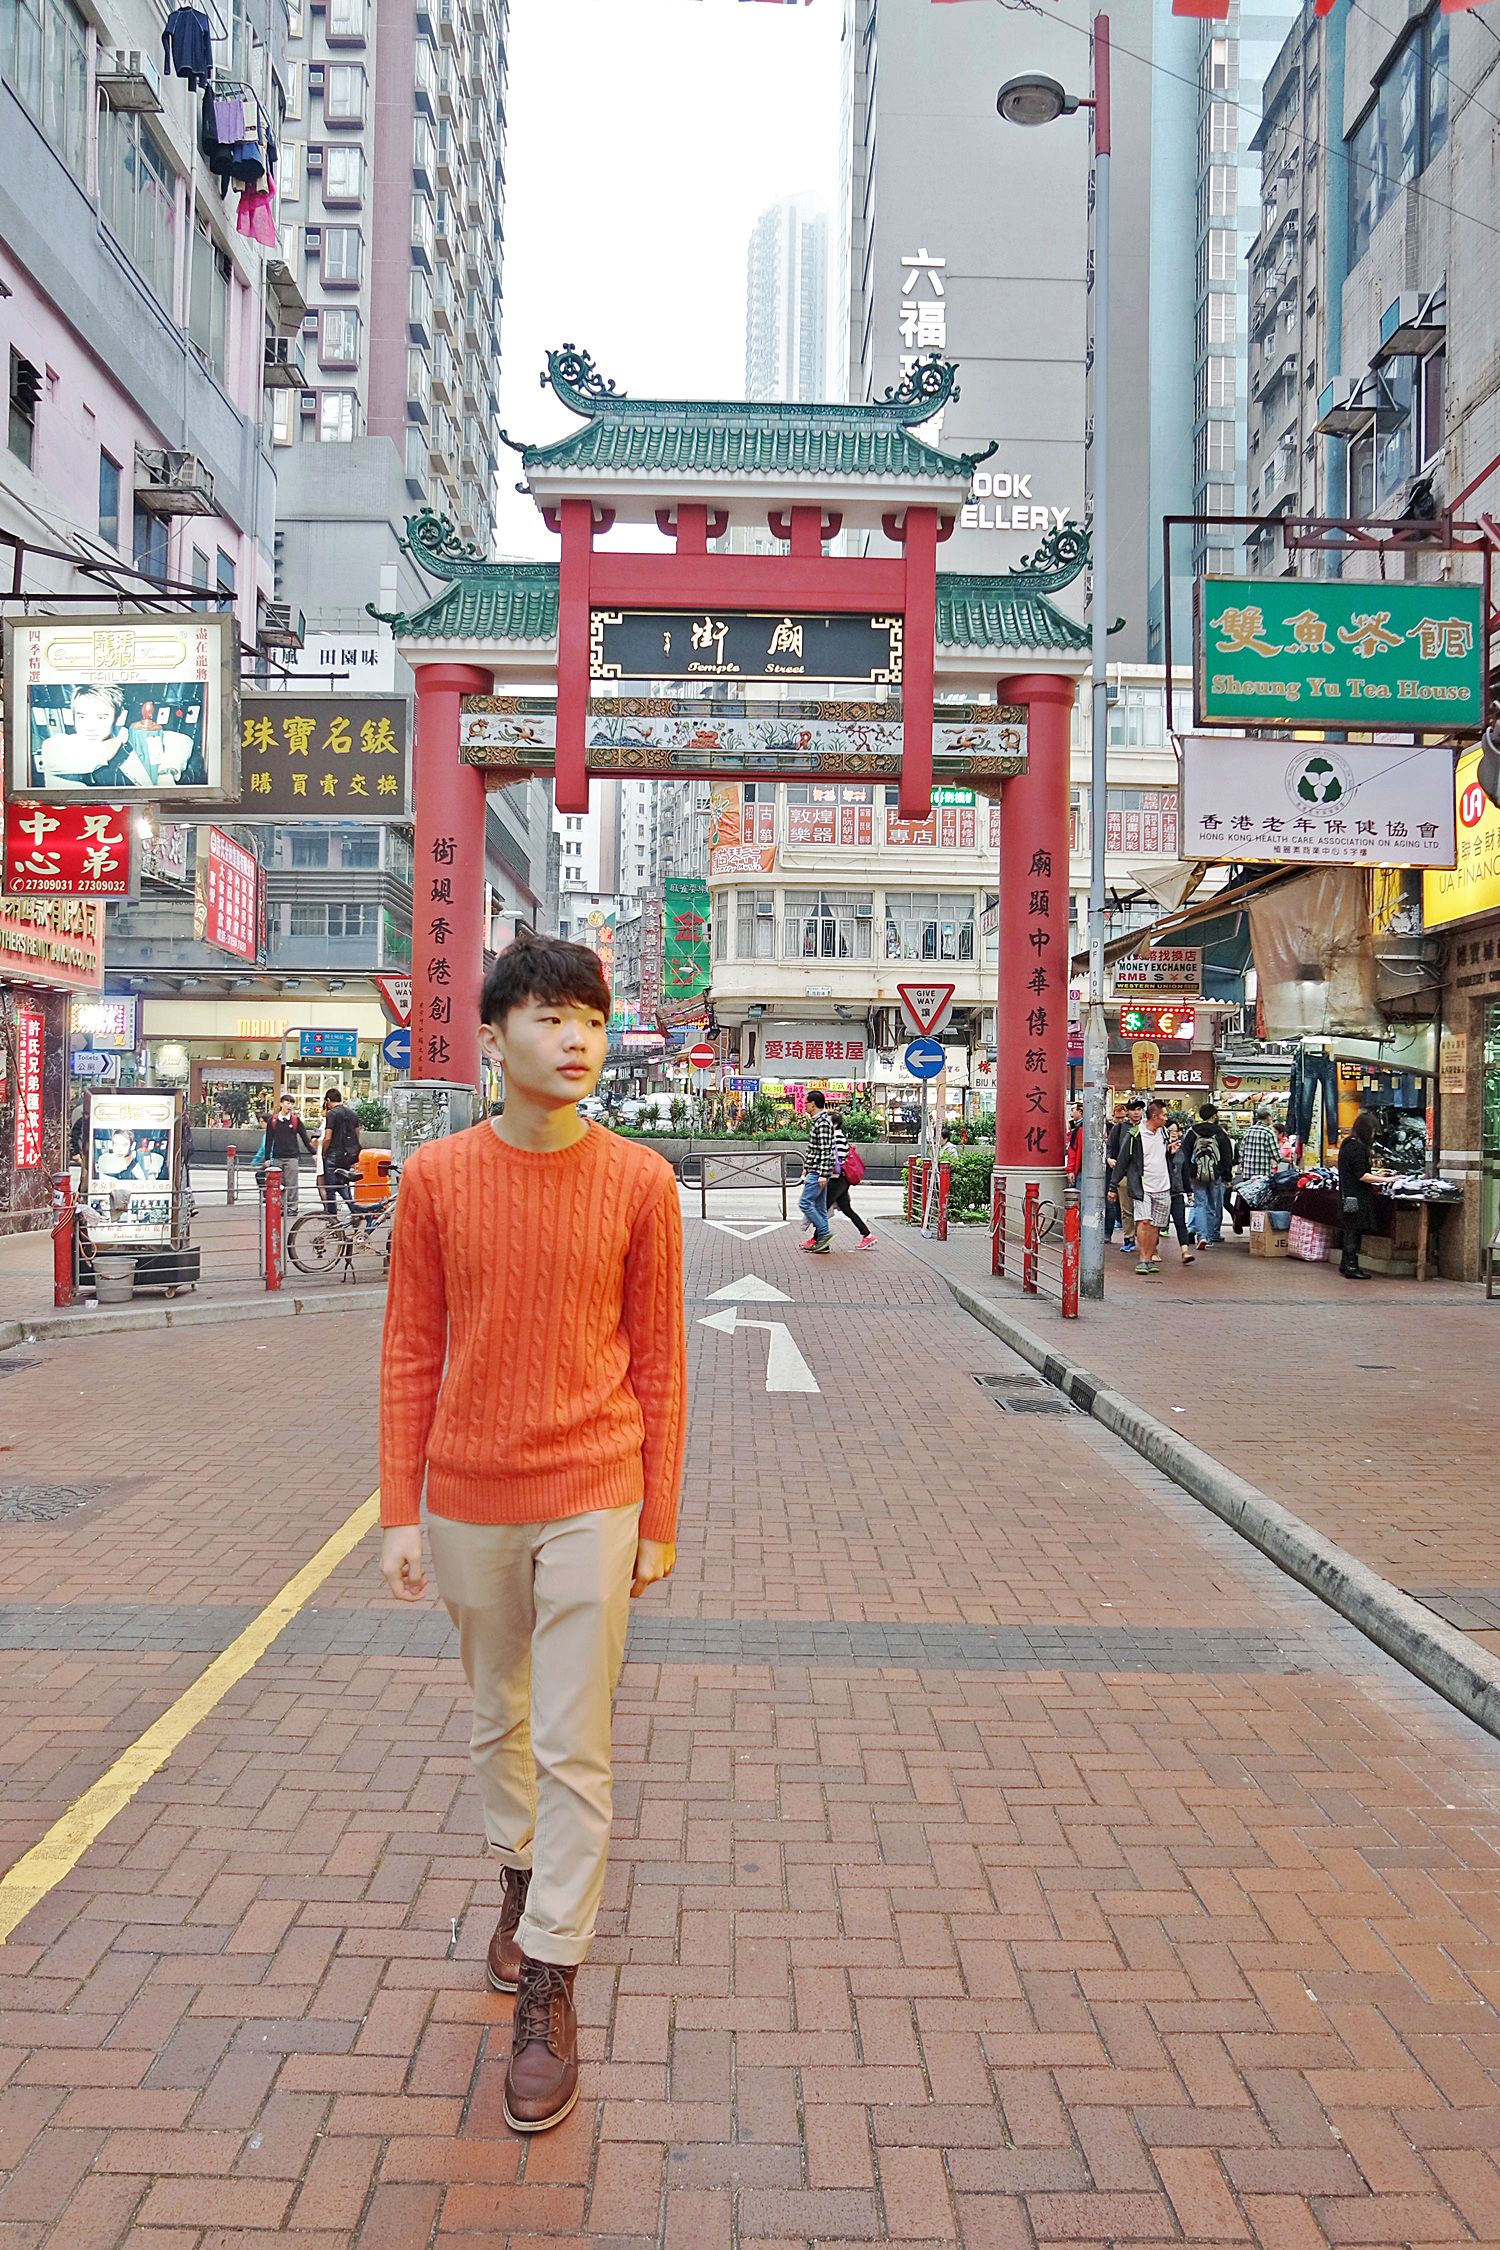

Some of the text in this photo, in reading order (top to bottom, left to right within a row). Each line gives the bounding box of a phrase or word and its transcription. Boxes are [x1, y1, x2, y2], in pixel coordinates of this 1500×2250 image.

[1209, 606, 1473, 659] 雙魚茶館
[28, 630, 41, 683] 四季精選
[195, 628, 209, 680] 盡在龍將
[687, 662, 806, 674] Temple Street
[1211, 675, 1470, 701] Sheung Yu Tea House
[241, 716, 399, 757] 珠寶名錶
[241, 772, 273, 795] 購
[790, 809, 834, 825] 敦煌
[1199, 813, 1440, 840] 香港老年保健協會
[15, 806, 62, 876] 中心
[76, 806, 124, 880] 兄弟
[790, 828, 833, 842] 樂器
[1199, 832, 1225, 841] HONG
[1228, 833, 1254, 842] KONG
[1255, 834, 1288, 844] HEALTH
[1291, 836, 1314, 844] CARE
[1318, 837, 1376, 847] ASSOCIATION
[1378, 839, 1391, 847] ON
[1394, 839, 1421, 849] AGING
[25, 878, 126, 892] 27309031 27309032
[1439, 873, 1454, 895] UA
[0, 929, 26, 953] THERS
[427, 837, 458, 1081] 街現香港創新
[1119, 963, 1197, 972] MONEY EXCHANGE
[1118, 973, 1147, 981] RMB
[921, 1007, 931, 1017] 讓
[236, 1018, 289, 1038] MAPLE
[764, 1040, 864, 1060] 愛琦麗鞋屋
[25, 1019, 42, 1165] 許氏兄弟匯款中心
[975, 1078, 989, 1087] BIU
[17, 1123, 26, 1165] CENTRE
